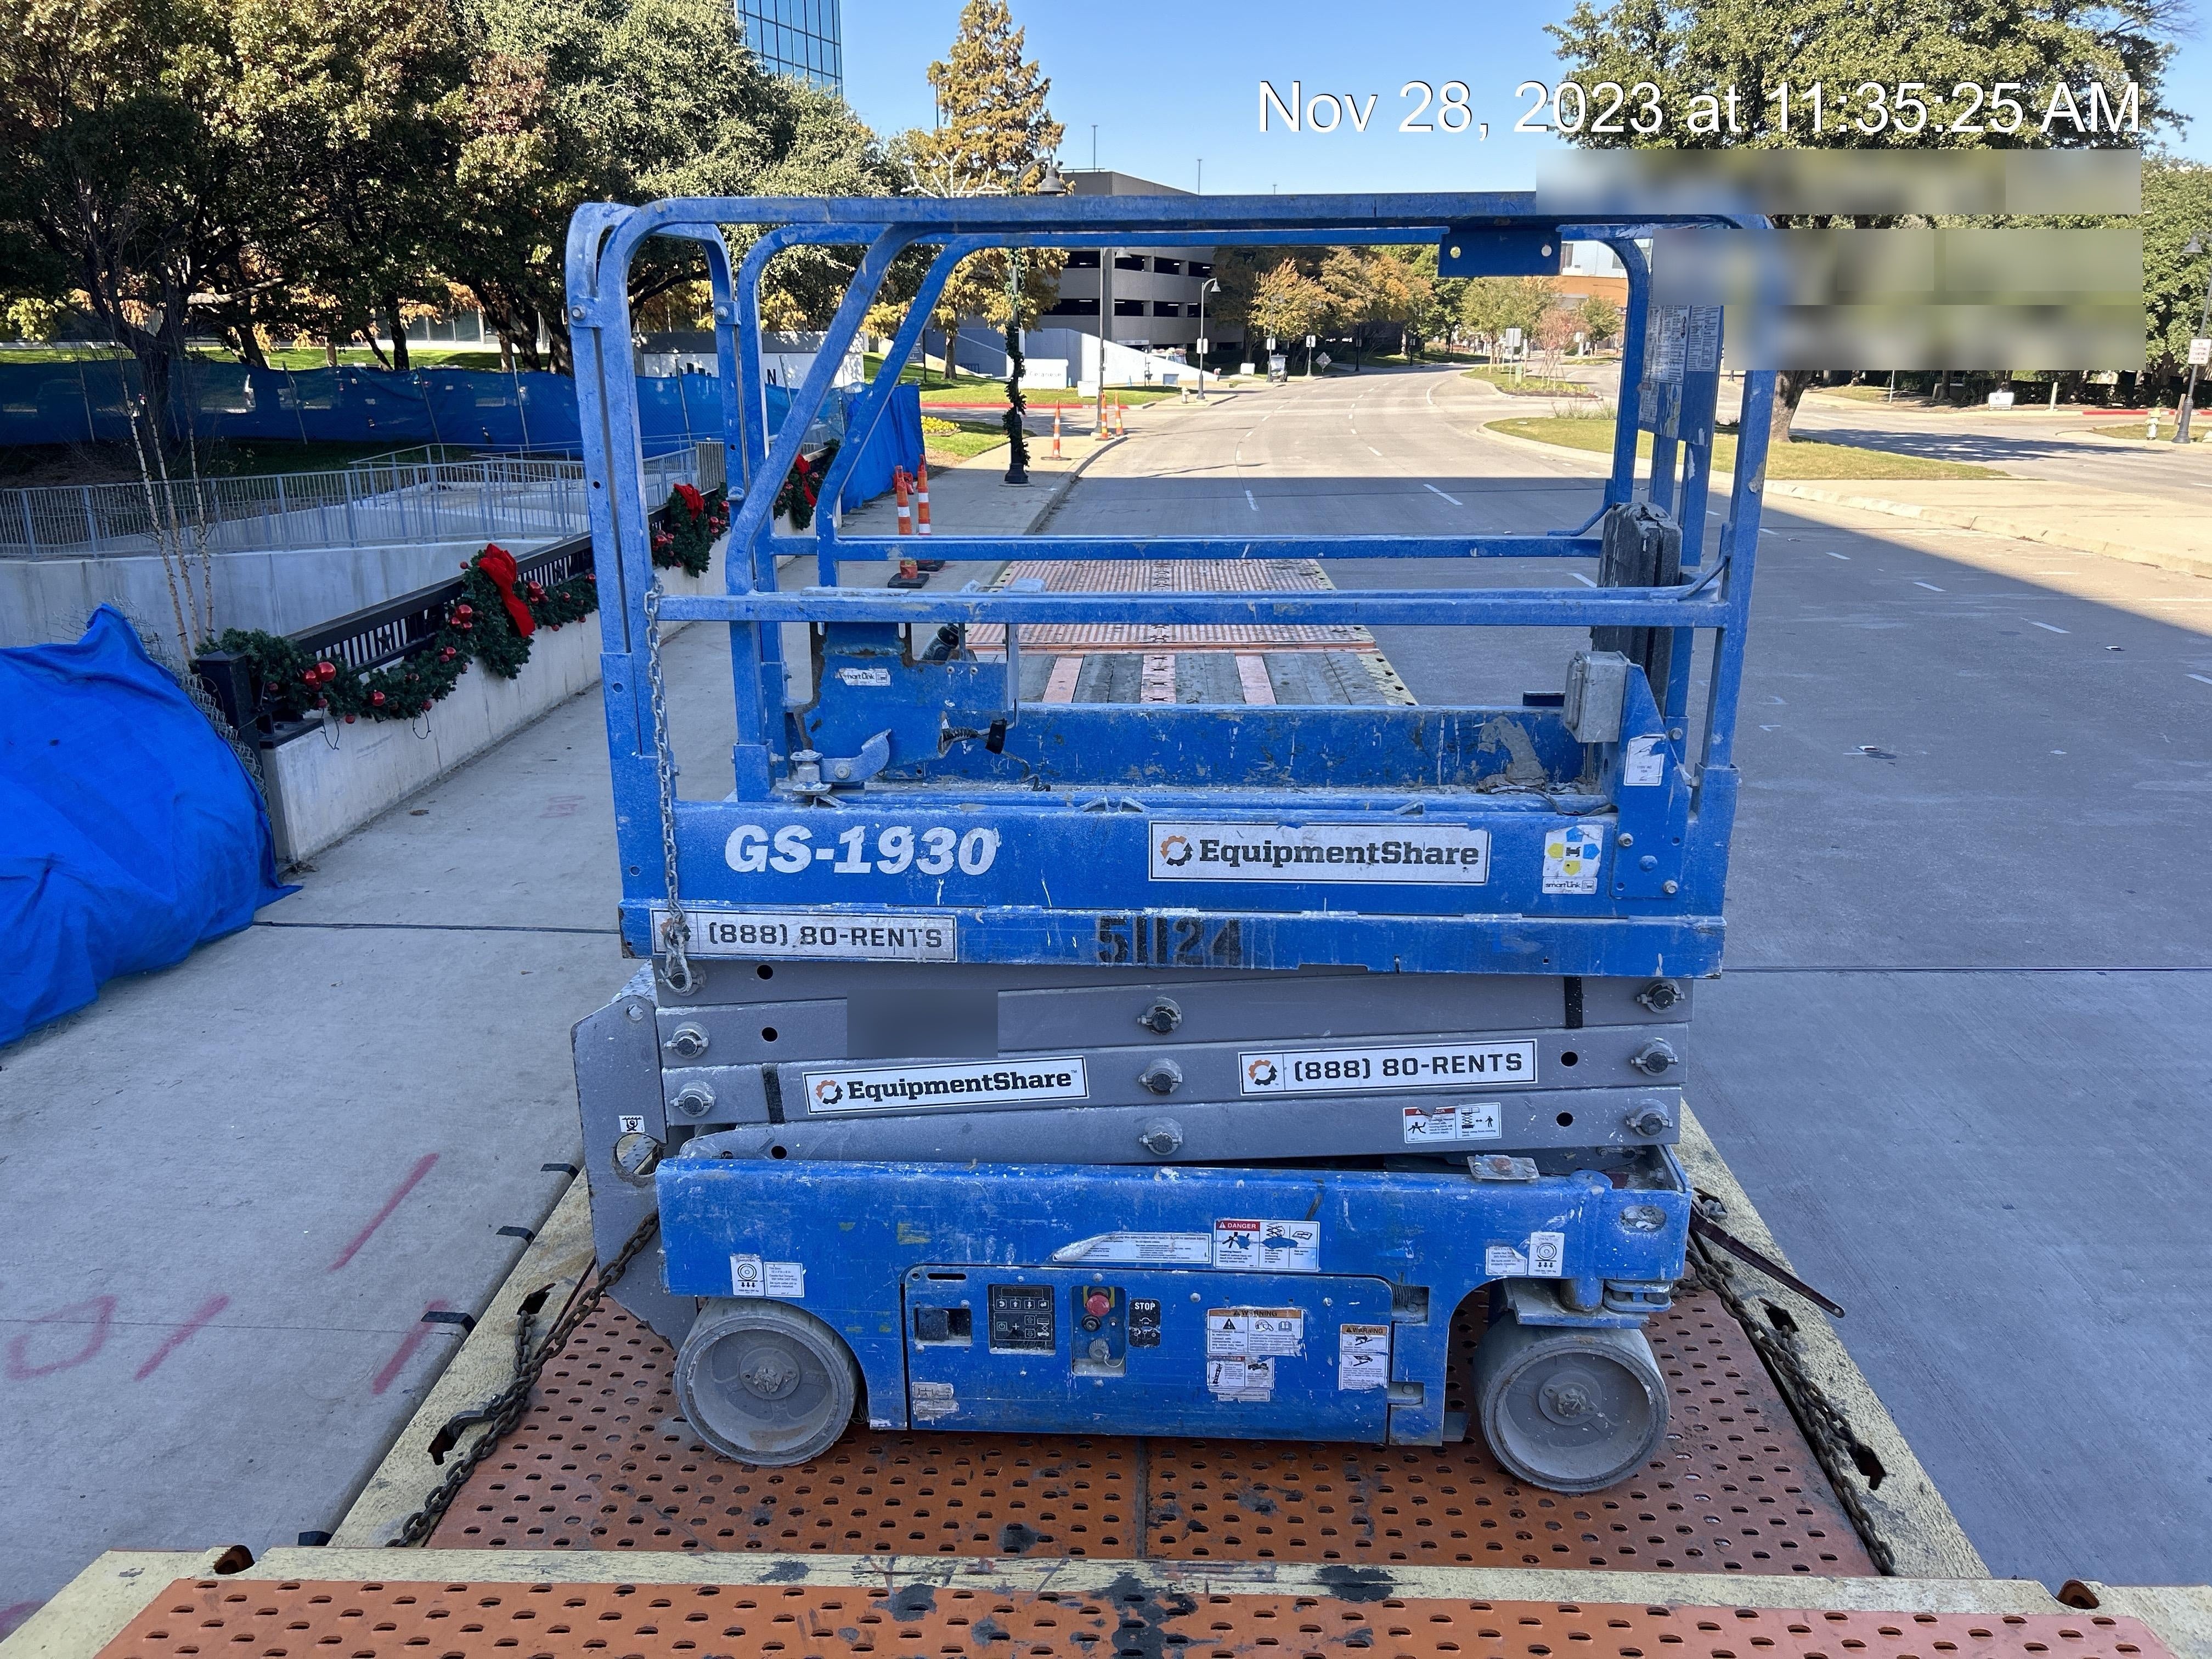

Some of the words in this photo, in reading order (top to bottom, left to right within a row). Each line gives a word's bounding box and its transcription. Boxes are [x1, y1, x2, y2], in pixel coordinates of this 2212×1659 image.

[725, 824, 1001, 876] GS-1930
[1199, 838, 1479, 868] EquipmentShare
[709, 922, 788, 946] (888)
[799, 926, 943, 948] 80-RENTS
[1098, 915, 1242, 967] 51124
[1295, 1058, 1370, 1081] (888)
[1382, 1051, 1522, 1077] 80-RENTS
[848, 1071, 1072, 1102] EquipmentShare
[1135, 1302, 1155, 1310] STOP
